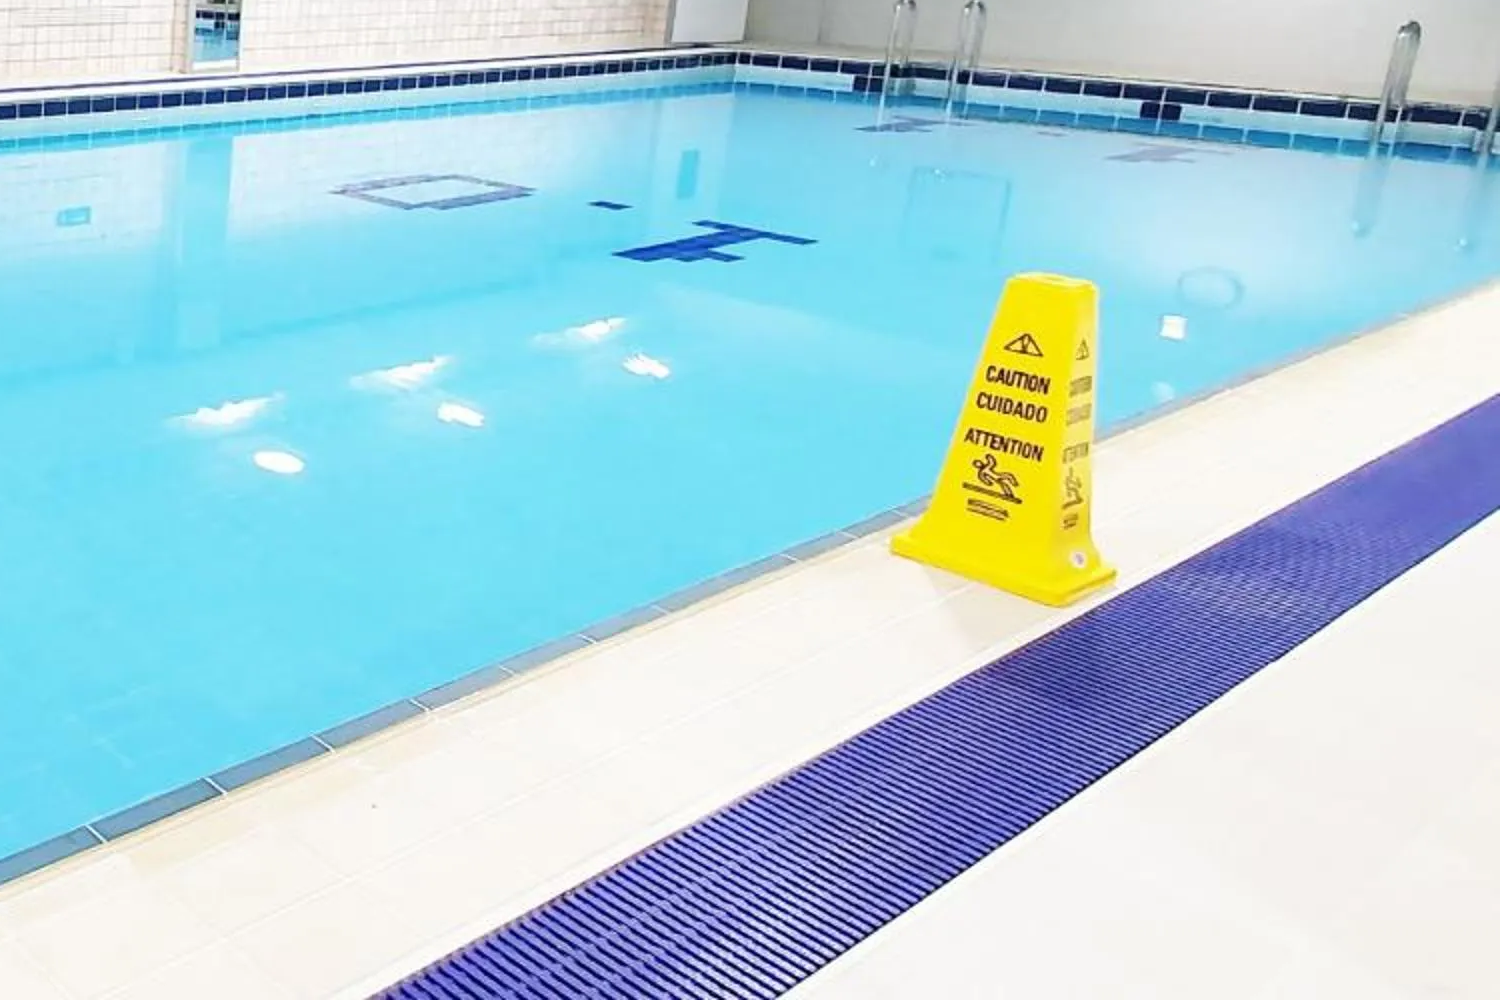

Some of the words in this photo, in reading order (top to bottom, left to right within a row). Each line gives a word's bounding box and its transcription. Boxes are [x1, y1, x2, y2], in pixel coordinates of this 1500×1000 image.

[985, 365, 1051, 395] CAUTION
[976, 391, 1048, 423] CUIDADO
[964, 427, 1044, 462] ATTENTION
